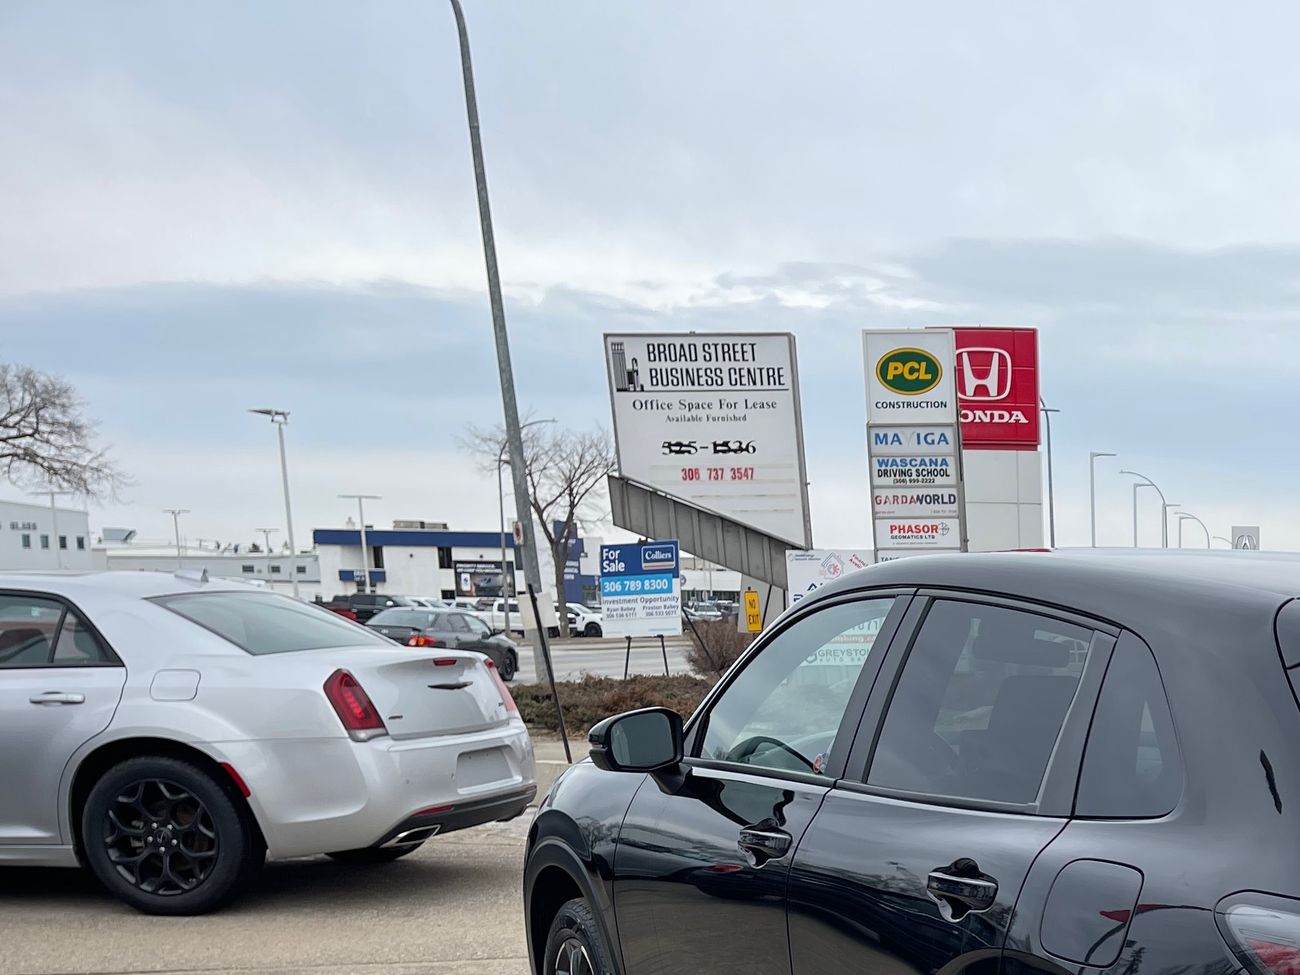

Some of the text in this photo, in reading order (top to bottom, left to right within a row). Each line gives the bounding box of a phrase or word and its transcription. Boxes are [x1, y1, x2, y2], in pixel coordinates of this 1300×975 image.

[647, 343, 757, 362] BROAD STREET
[650, 366, 785, 387] BUSINESS CENTRE
[886, 361, 932, 380] PCL
[632, 398, 777, 412] Office Space For Lease
[875, 400, 947, 410] CONSTRUCTION
[665, 414, 747, 423] Available Furnished
[959, 410, 1029, 424] ONDA
[877, 458, 949, 468] WASCANA
[681, 467, 755, 481] 306 737 3547
[877, 468, 950, 478] DRIVING SCHOOL
[875, 493, 956, 506] GARDAWORLD
[890, 525, 938, 534] PHASOR
[603, 549, 621, 560] For
[645, 550, 672, 560] Colliers
[602, 560, 625, 573] Sale
[604, 578, 668, 593] 306 789 8300
[603, 595, 679, 605] Investment Opportunity
[748, 613, 760, 625] EXIT
